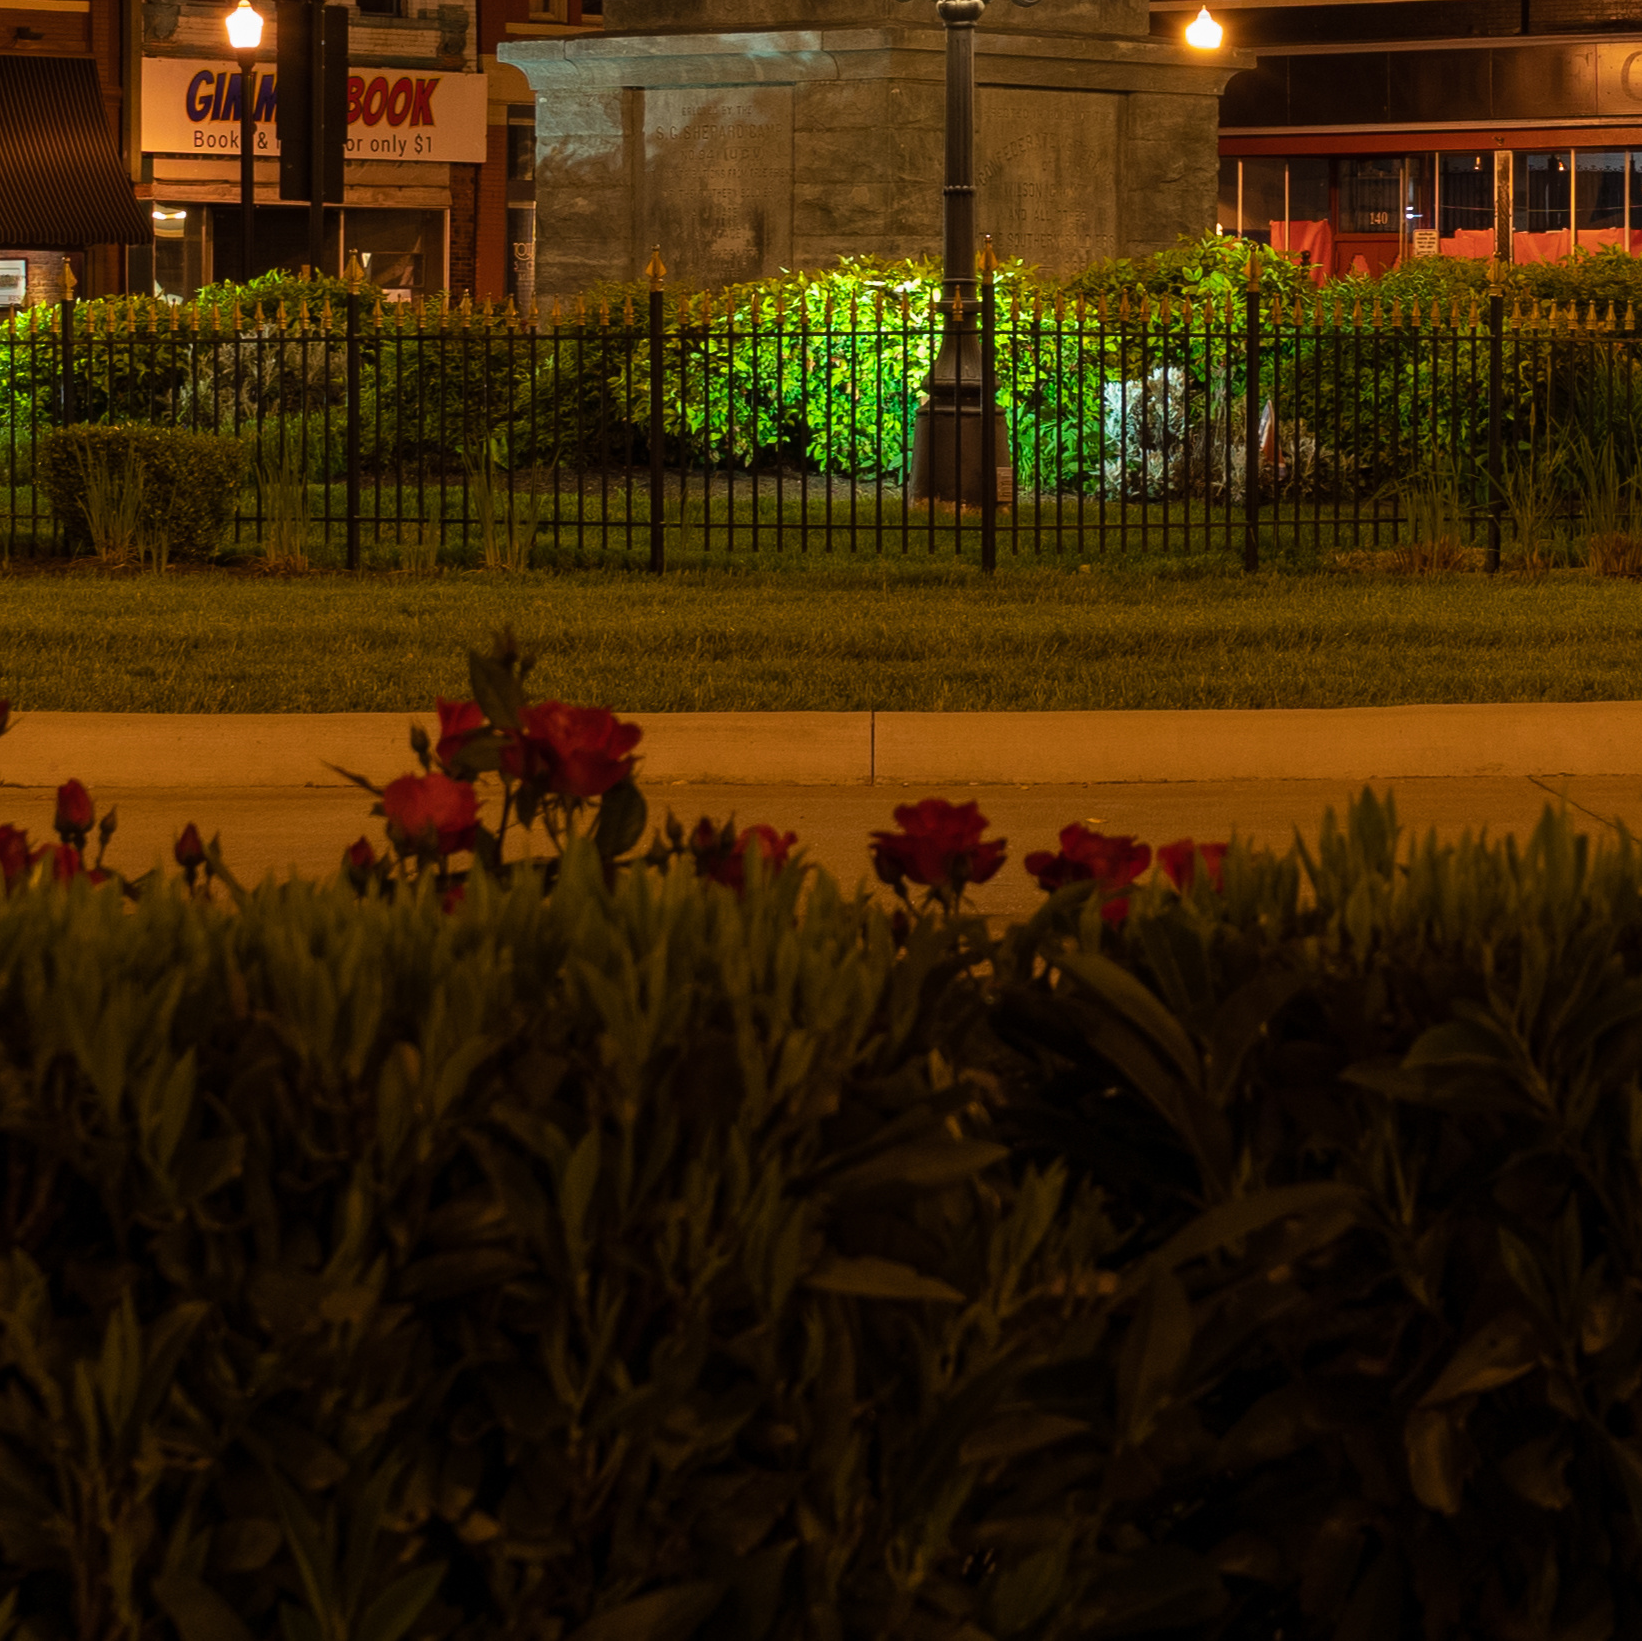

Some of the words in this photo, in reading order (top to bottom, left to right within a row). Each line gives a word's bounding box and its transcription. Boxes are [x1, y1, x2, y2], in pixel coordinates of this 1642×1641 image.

[193, 131, 240, 150] Book
[258, 132, 269, 149] &
[370, 137, 407, 157] only
[414, 135, 432, 154] $1
[1370, 212, 1389, 225] 140
